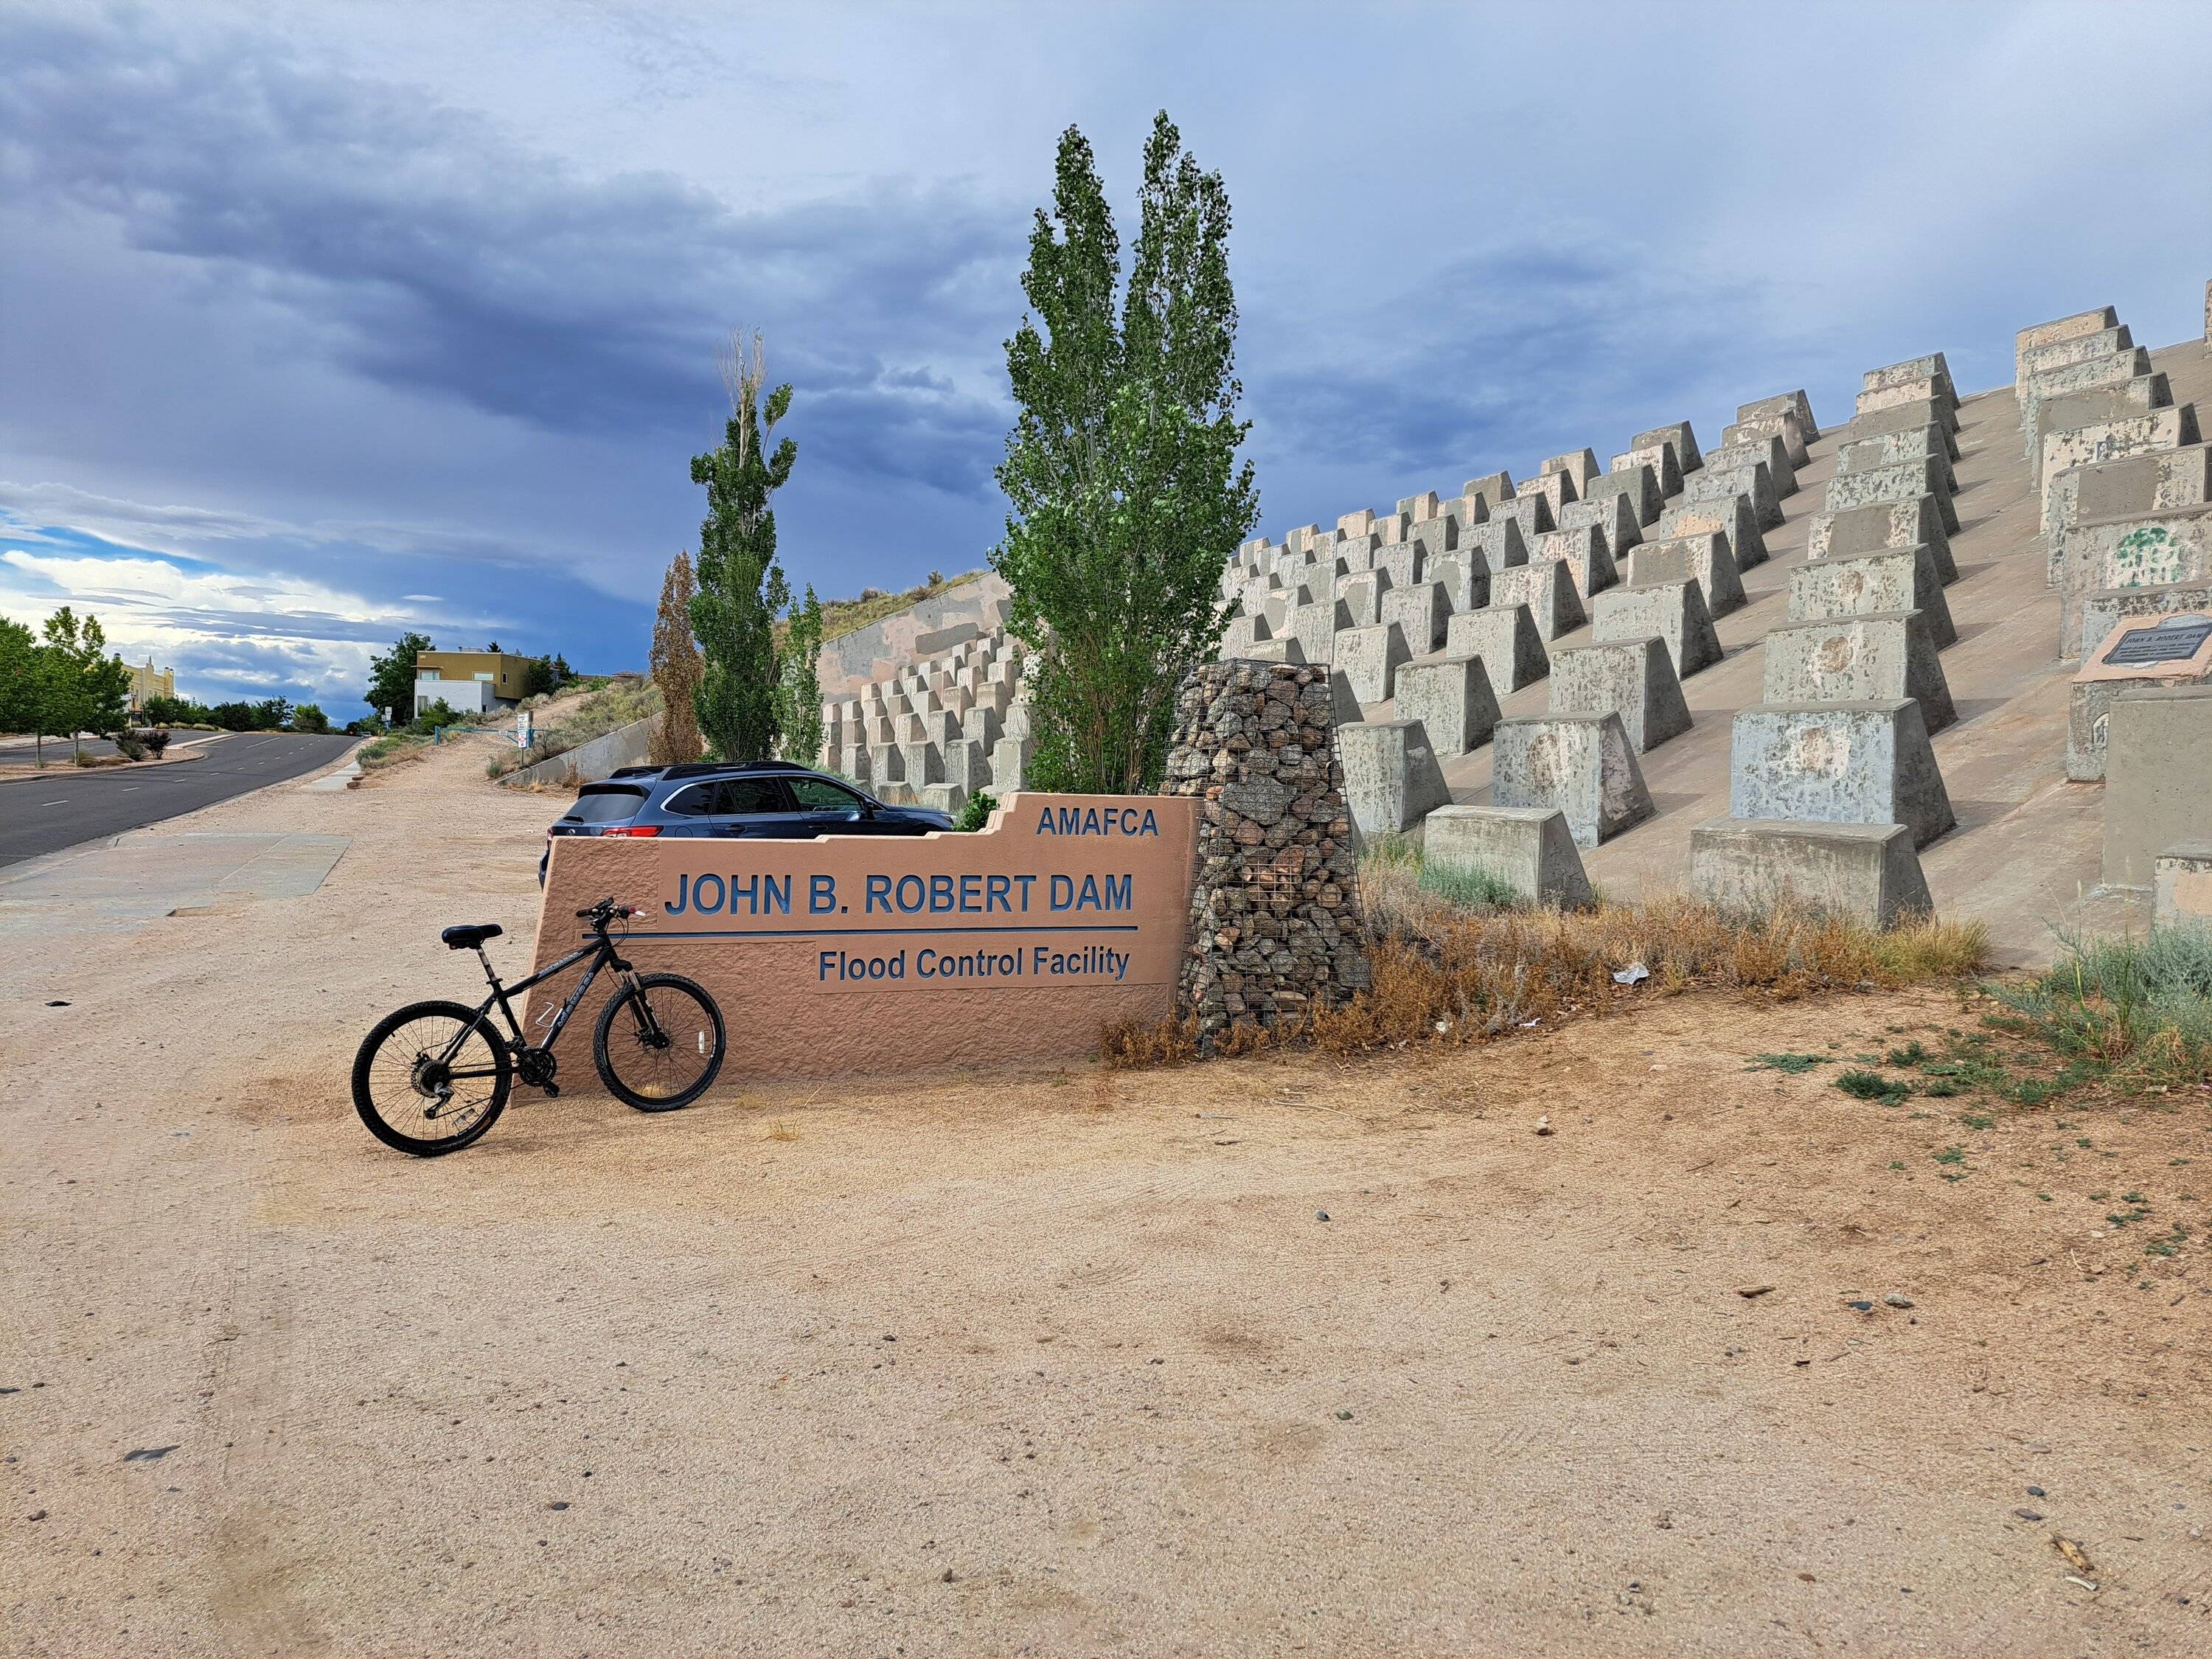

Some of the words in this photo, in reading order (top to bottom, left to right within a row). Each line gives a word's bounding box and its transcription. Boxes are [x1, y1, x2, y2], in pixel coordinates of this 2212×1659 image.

[1036, 807, 1159, 837] AMAFCA
[664, 873, 792, 915] JOHN
[809, 874, 849, 914] B.
[866, 874, 1037, 914] ROBERT
[1049, 874, 1133, 912] DAM
[819, 949, 905, 981] Flood
[917, 947, 1023, 978] Control
[1033, 945, 1130, 981] Facility
